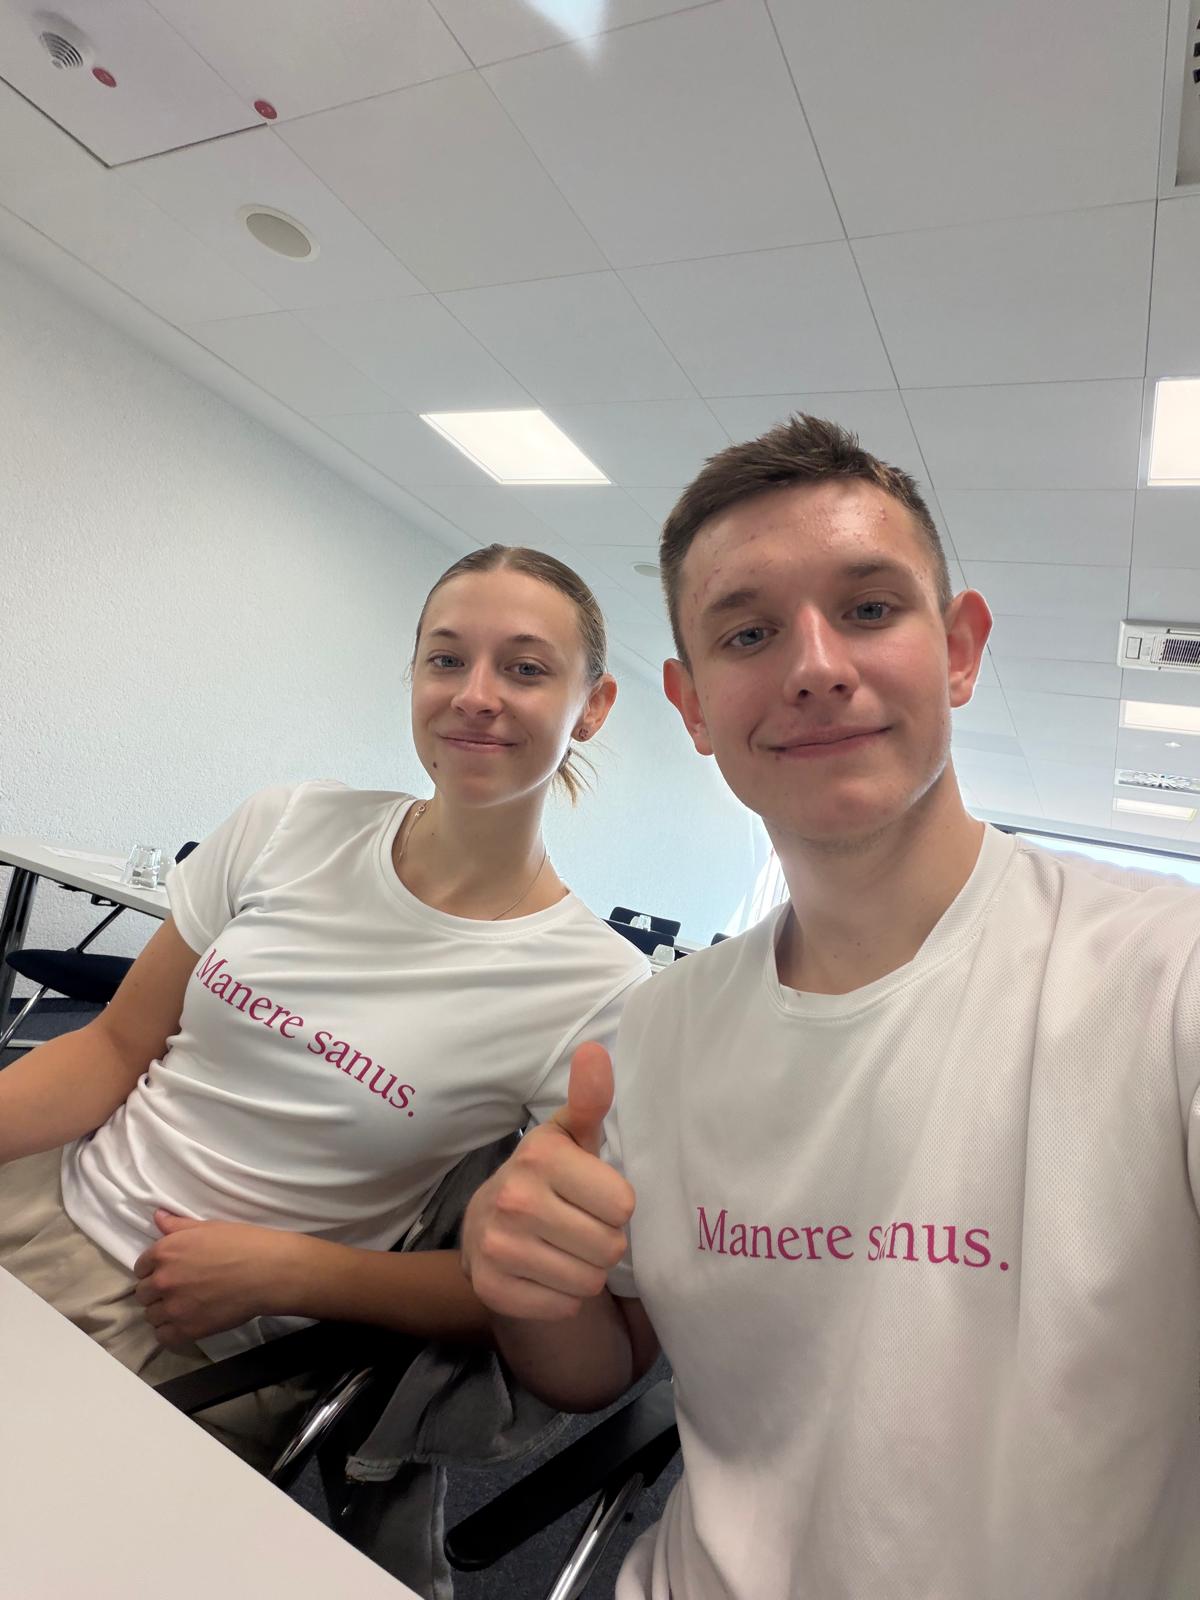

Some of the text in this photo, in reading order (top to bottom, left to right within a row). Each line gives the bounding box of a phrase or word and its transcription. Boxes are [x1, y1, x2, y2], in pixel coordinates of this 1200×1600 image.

[195, 948, 417, 1118] Manere sanus.
[697, 1206, 854, 1262] Manere
